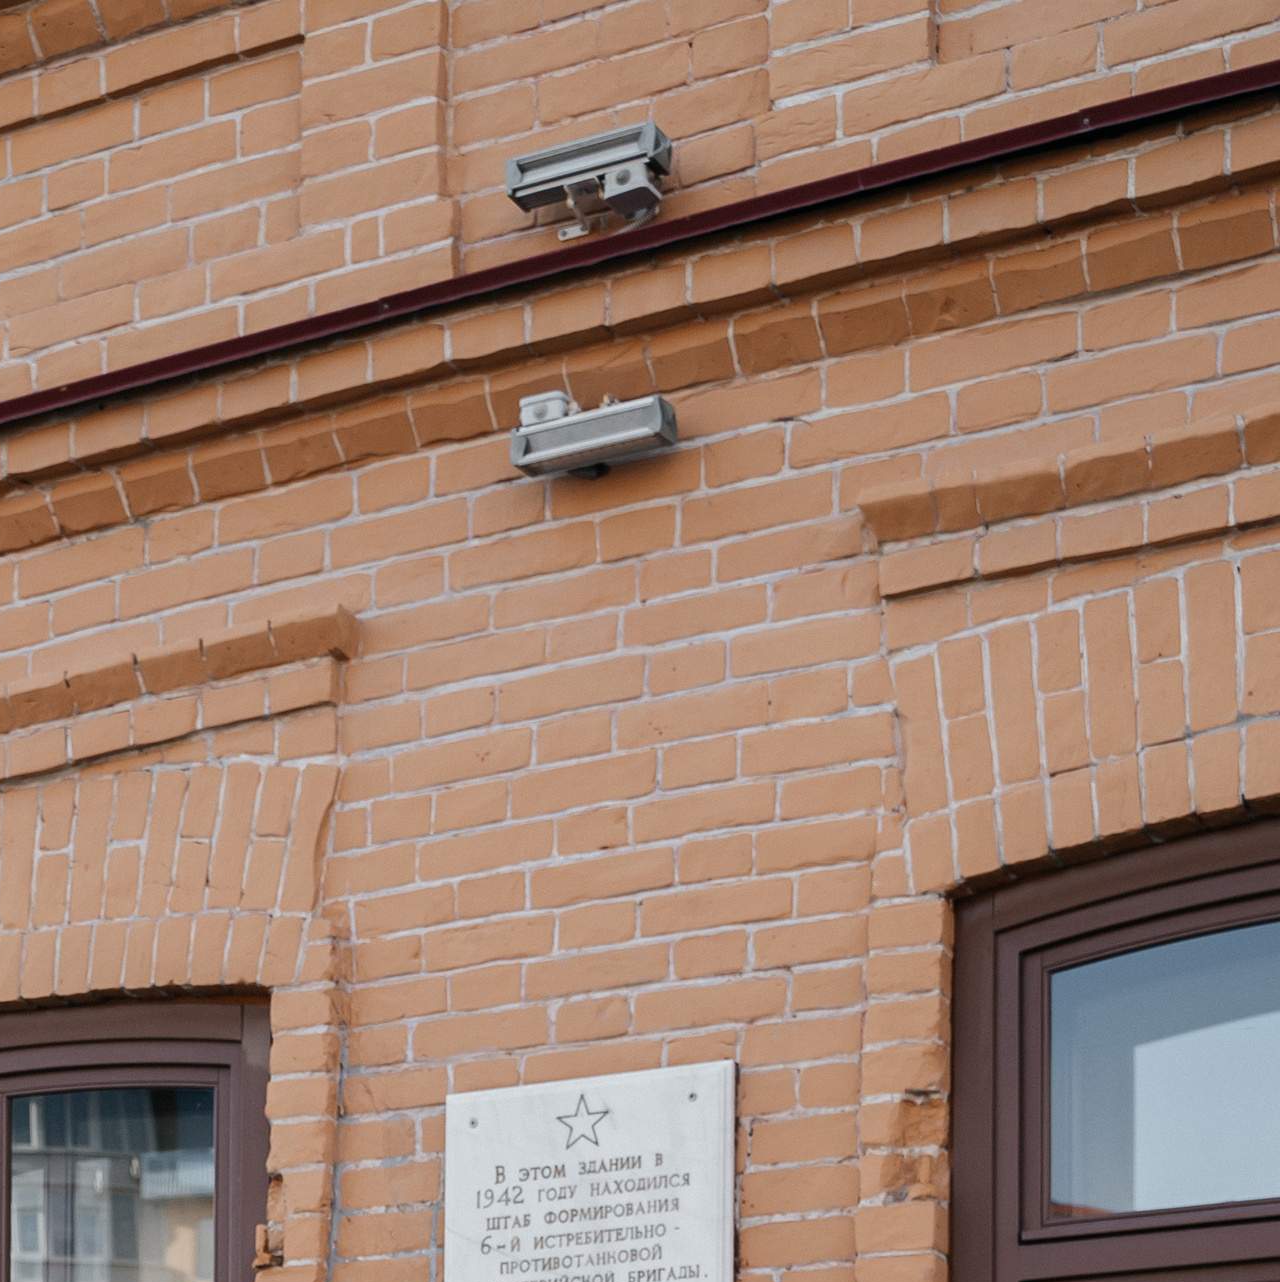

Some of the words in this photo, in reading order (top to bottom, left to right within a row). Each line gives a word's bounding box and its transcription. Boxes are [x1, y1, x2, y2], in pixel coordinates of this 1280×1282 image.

[494, 1165, 506, 1184] В
[519, 1163, 566, 1183] ЭТОМ
[578, 1155, 642, 1176] ЗДАНИИ
[655, 1153, 664, 1167] В
[475, 1185, 524, 1209] 1942
[538, 1185, 577, 1202] ГОДУ
[590, 1173, 691, 1197] НАХОДИЛСЯ
[486, 1214, 531, 1232] ШТАБ
[544, 1198, 680, 1225] ФОРМИРОВАНИЯ
[500, 1244, 662, 1275] ПРОТИВОТАНКОВОЙ
